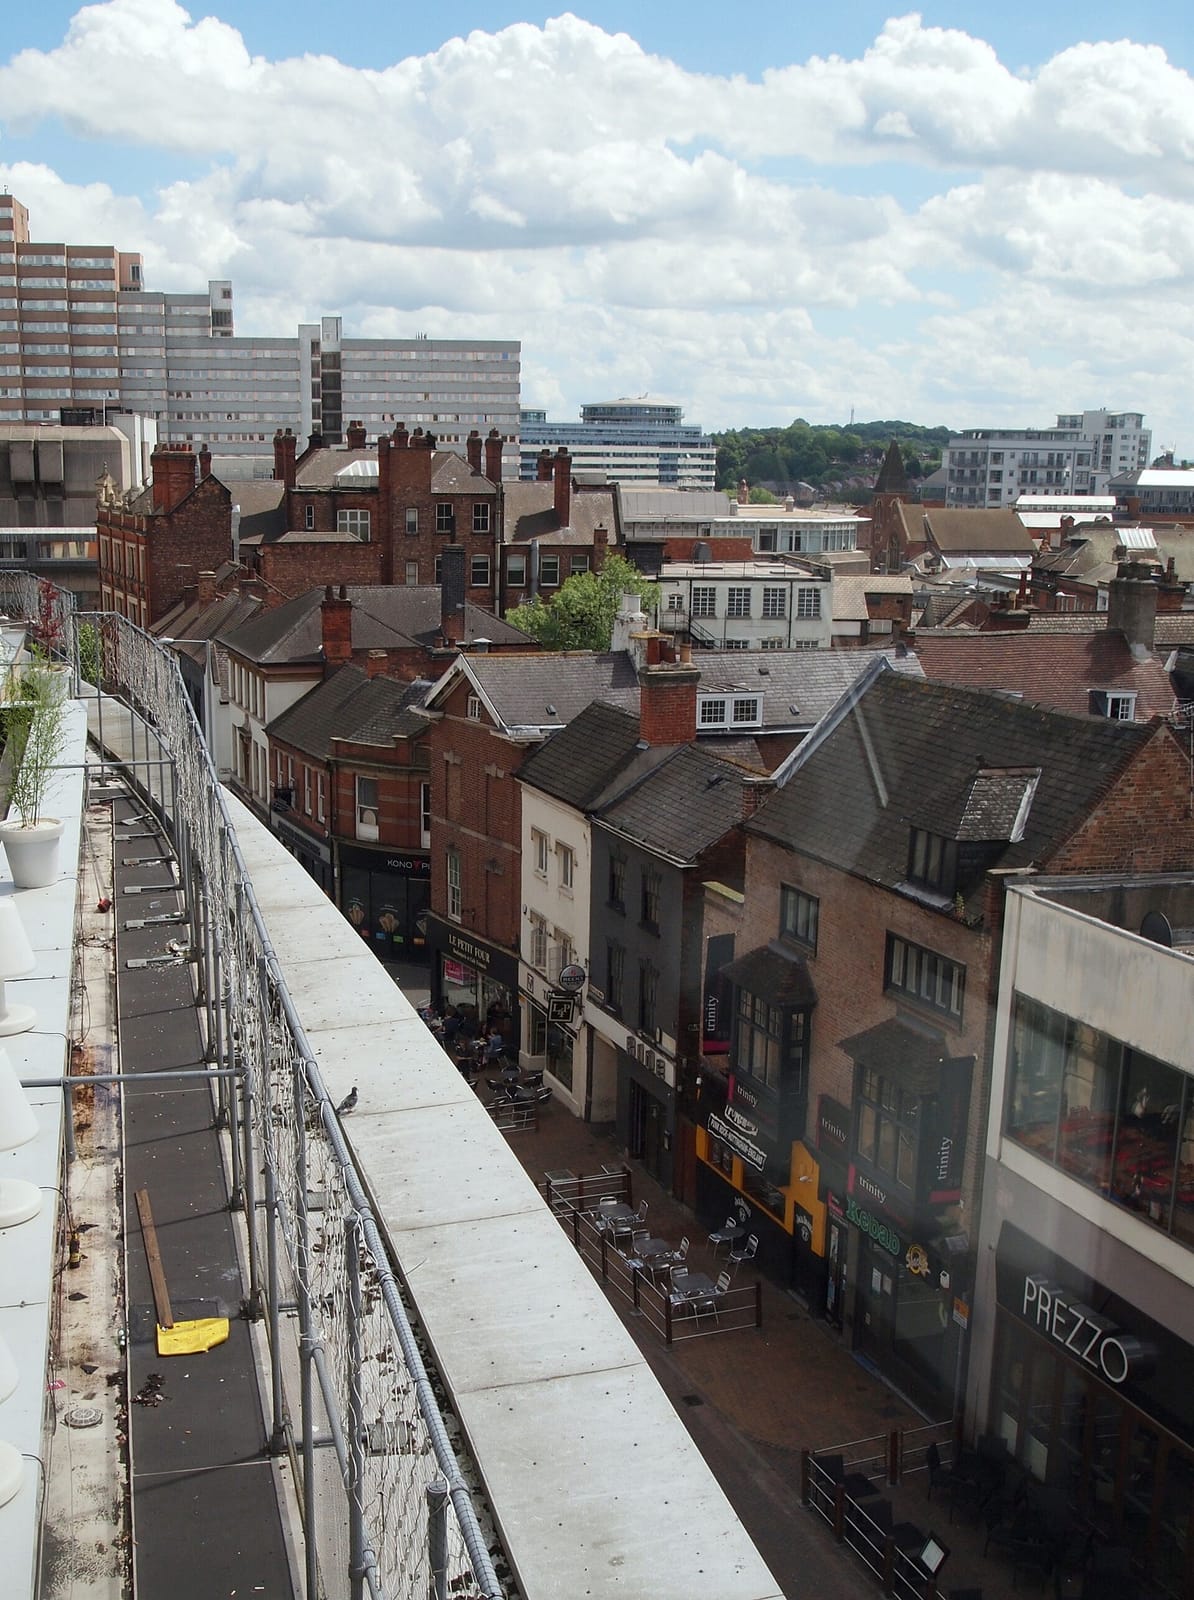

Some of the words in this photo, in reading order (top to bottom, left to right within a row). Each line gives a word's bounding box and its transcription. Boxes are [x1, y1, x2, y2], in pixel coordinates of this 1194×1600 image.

[387, 859, 413, 869] KONO
[449, 934, 457, 946] LE
[457, 938, 473, 954] PETIT
[474, 947, 490, 964] FOUR
[705, 995, 719, 1032] trinity
[737, 1084, 759, 1108] trinity
[822, 1117, 848, 1144] trinity
[937, 1136, 953, 1181] trinity
[859, 1176, 887, 1204] trinity
[846, 1197, 900, 1256] Kebab
[1023, 1275, 1129, 1384] PREZZO
